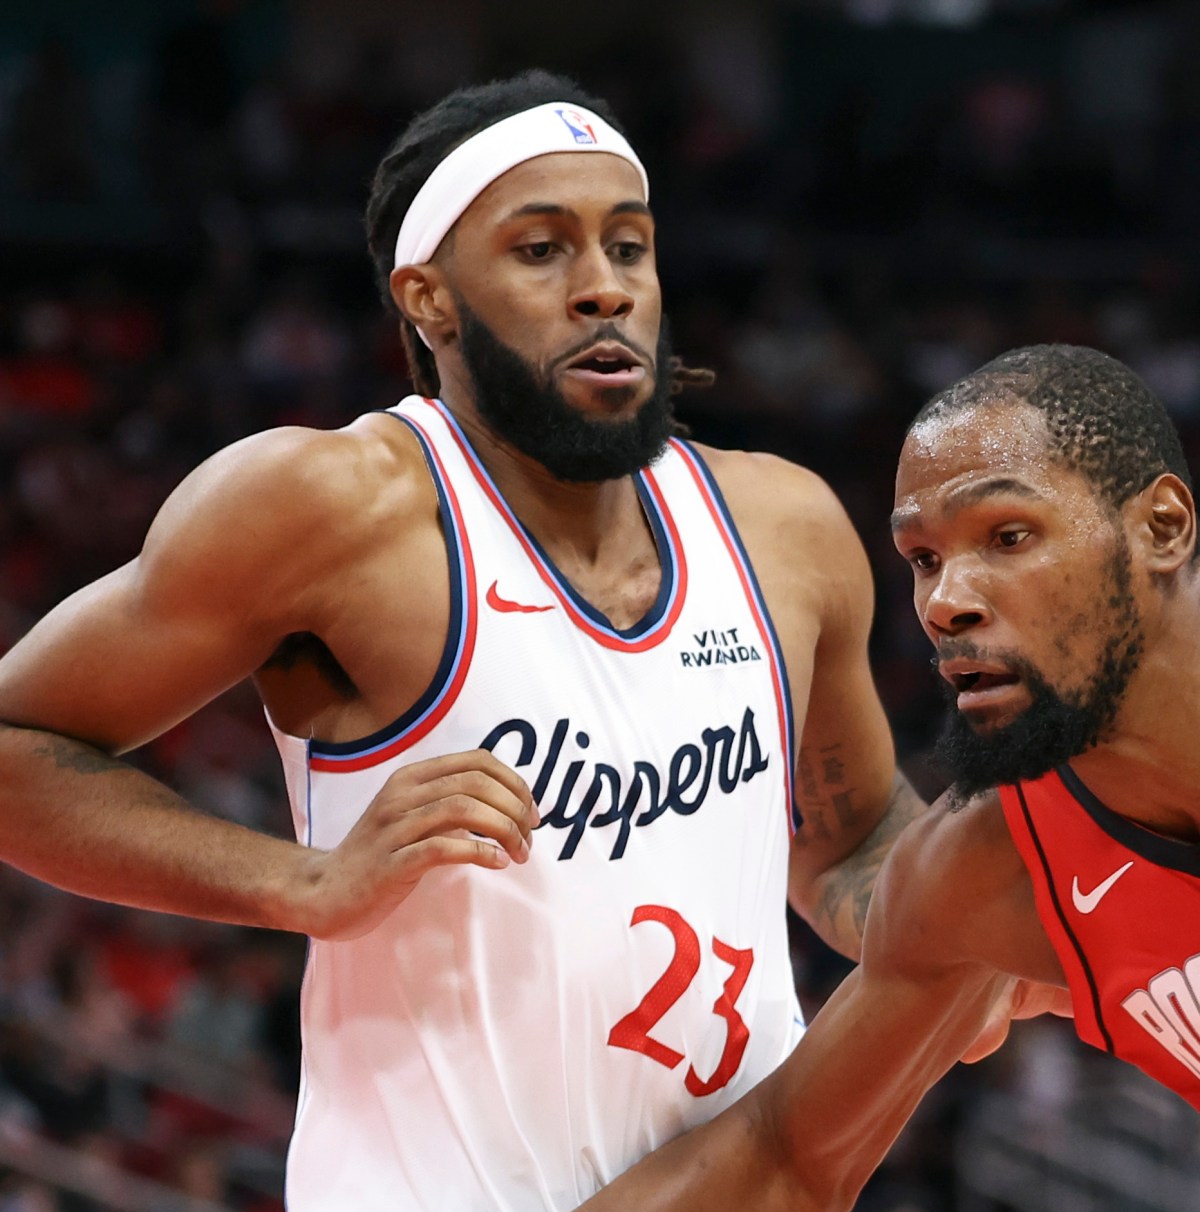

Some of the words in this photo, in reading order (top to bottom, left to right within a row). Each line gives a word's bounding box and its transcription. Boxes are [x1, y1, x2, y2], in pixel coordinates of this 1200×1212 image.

[693, 627, 739, 648] VIIT
[680, 645, 762, 667] RWANDA
[607, 904, 754, 1097] 23
